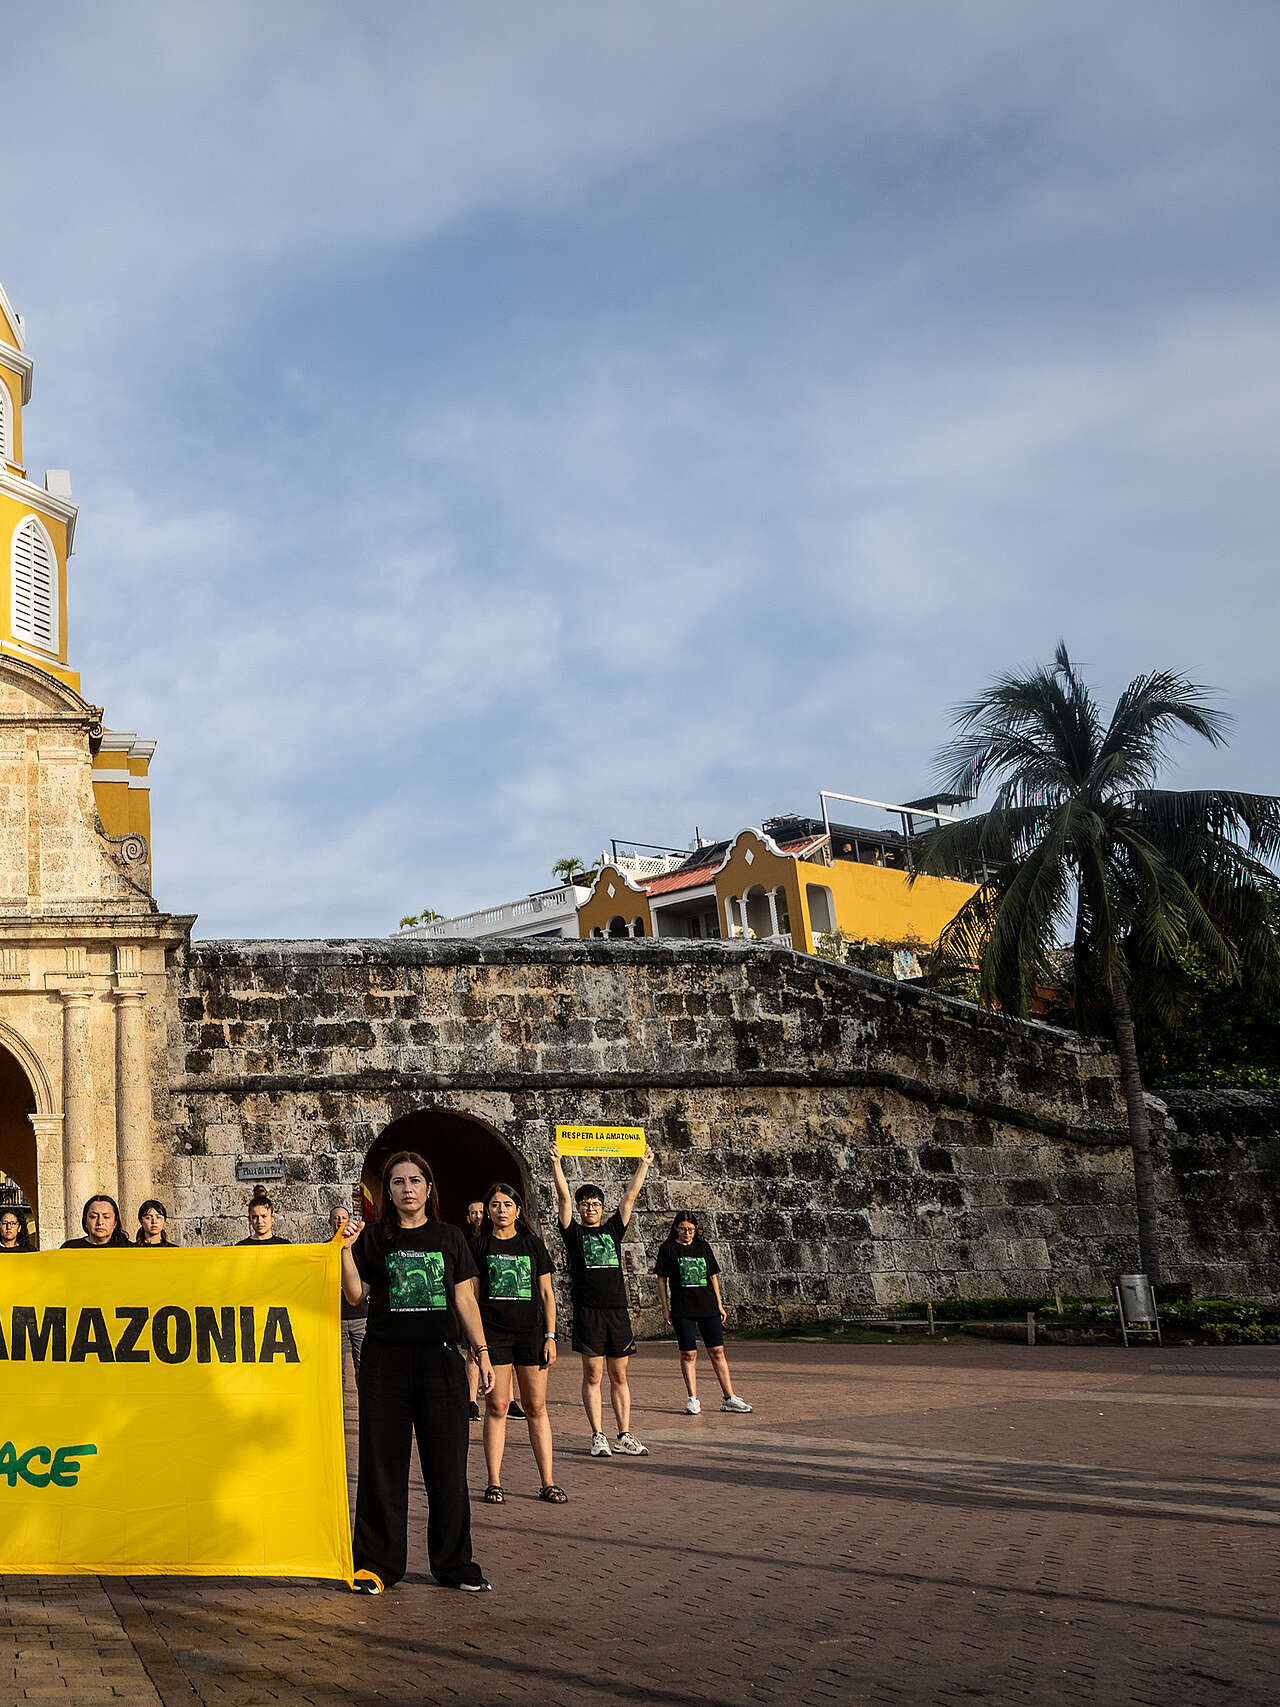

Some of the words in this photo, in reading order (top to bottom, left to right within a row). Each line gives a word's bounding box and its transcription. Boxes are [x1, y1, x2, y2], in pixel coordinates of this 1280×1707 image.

[561, 1131, 594, 1140] RESPETA
[595, 1132, 605, 1140] LA
[606, 1132, 641, 1141] AMAZONIA
